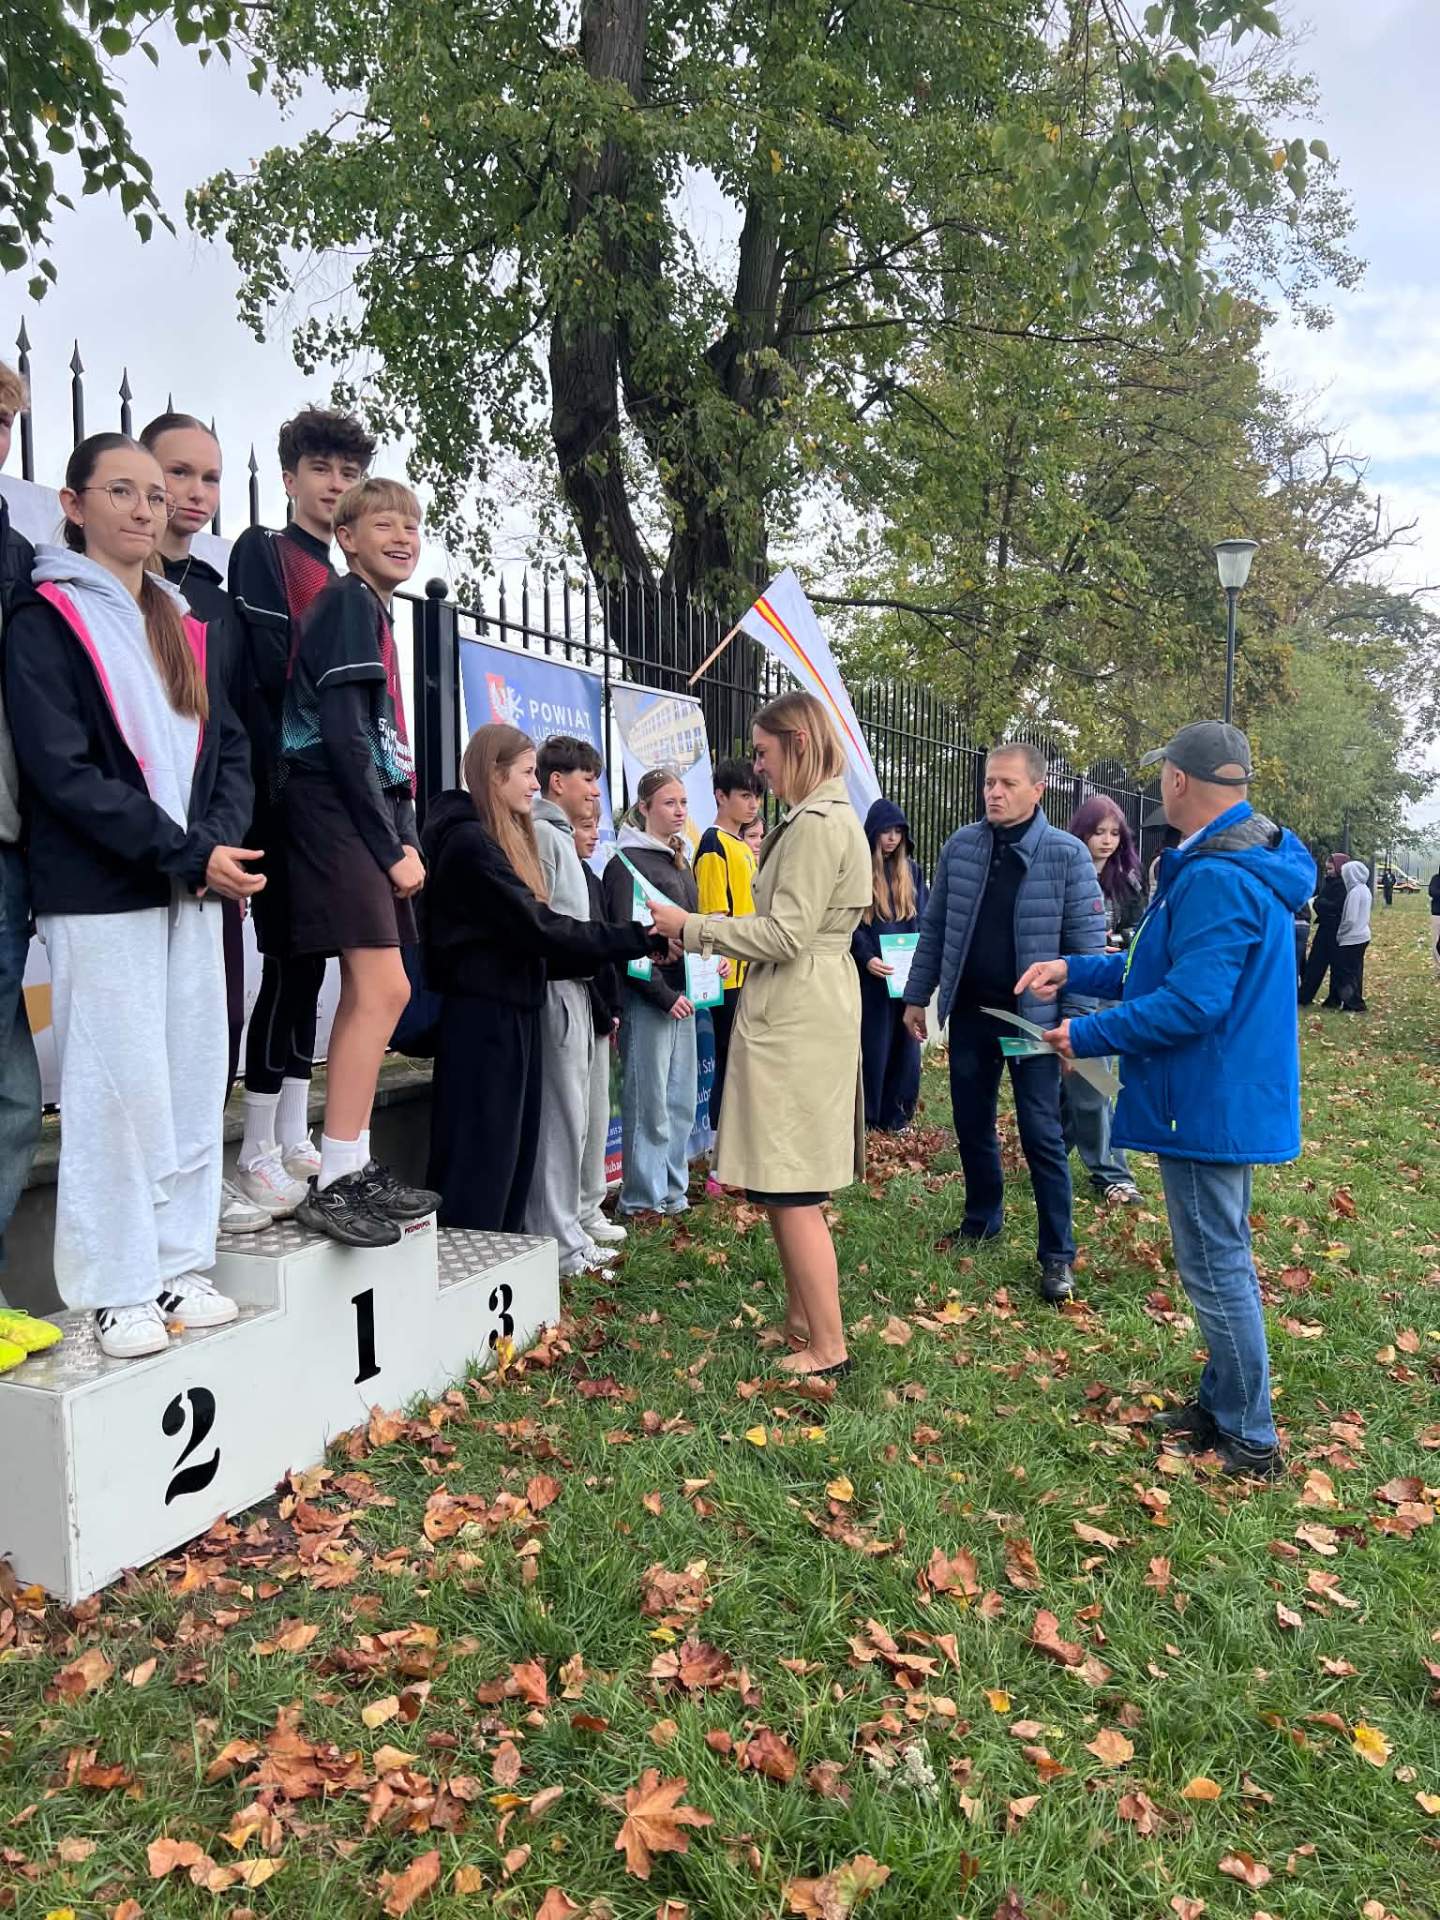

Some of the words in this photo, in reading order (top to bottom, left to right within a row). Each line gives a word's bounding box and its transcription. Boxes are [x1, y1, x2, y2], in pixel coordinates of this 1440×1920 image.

[529, 699, 592, 731] POWIAT
[351, 1288, 381, 1385] 1
[488, 1283, 515, 1350] 3
[161, 1386, 221, 1506] 2
